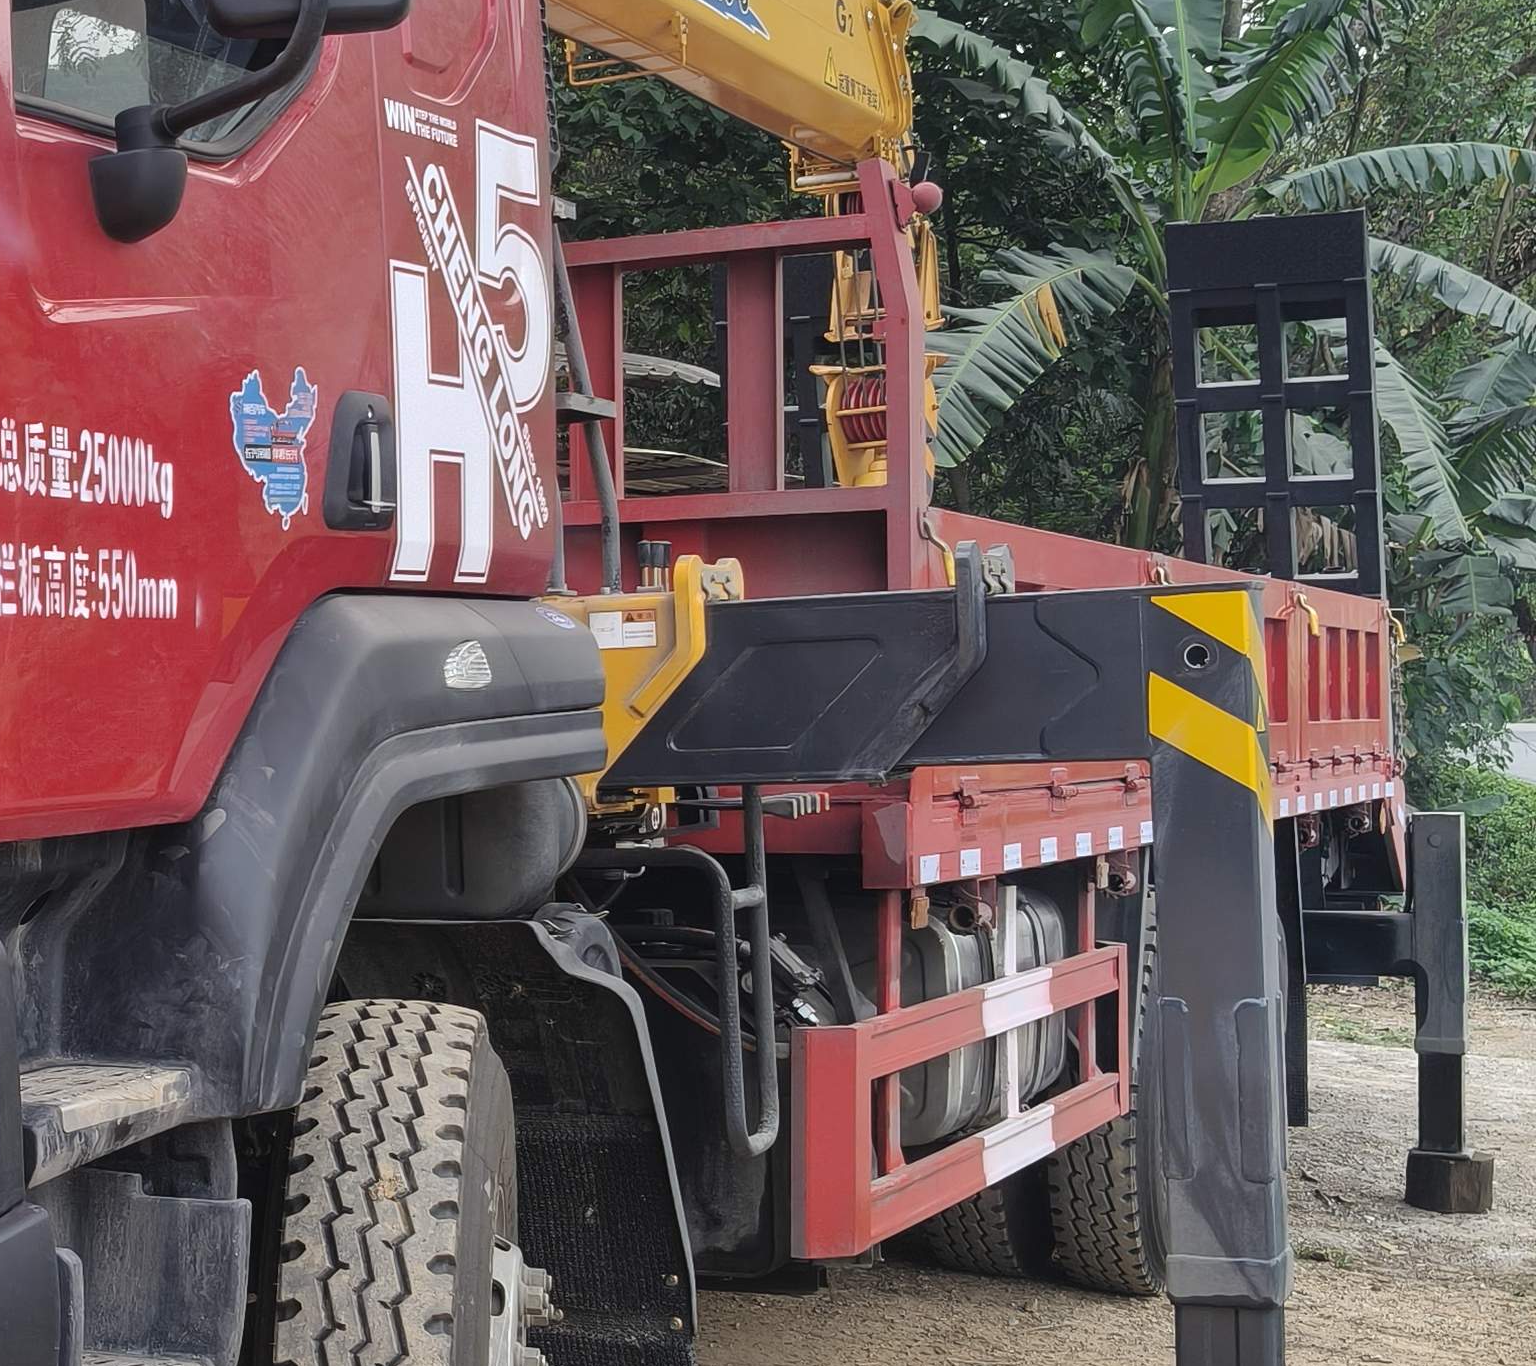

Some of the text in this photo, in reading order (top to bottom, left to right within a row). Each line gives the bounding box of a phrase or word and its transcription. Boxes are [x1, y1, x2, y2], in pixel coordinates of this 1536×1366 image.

[384, 98, 416, 135] WIN
[416, 122, 458, 148] THE FUTURE
[423, 163, 533, 541] CHENG LONG
